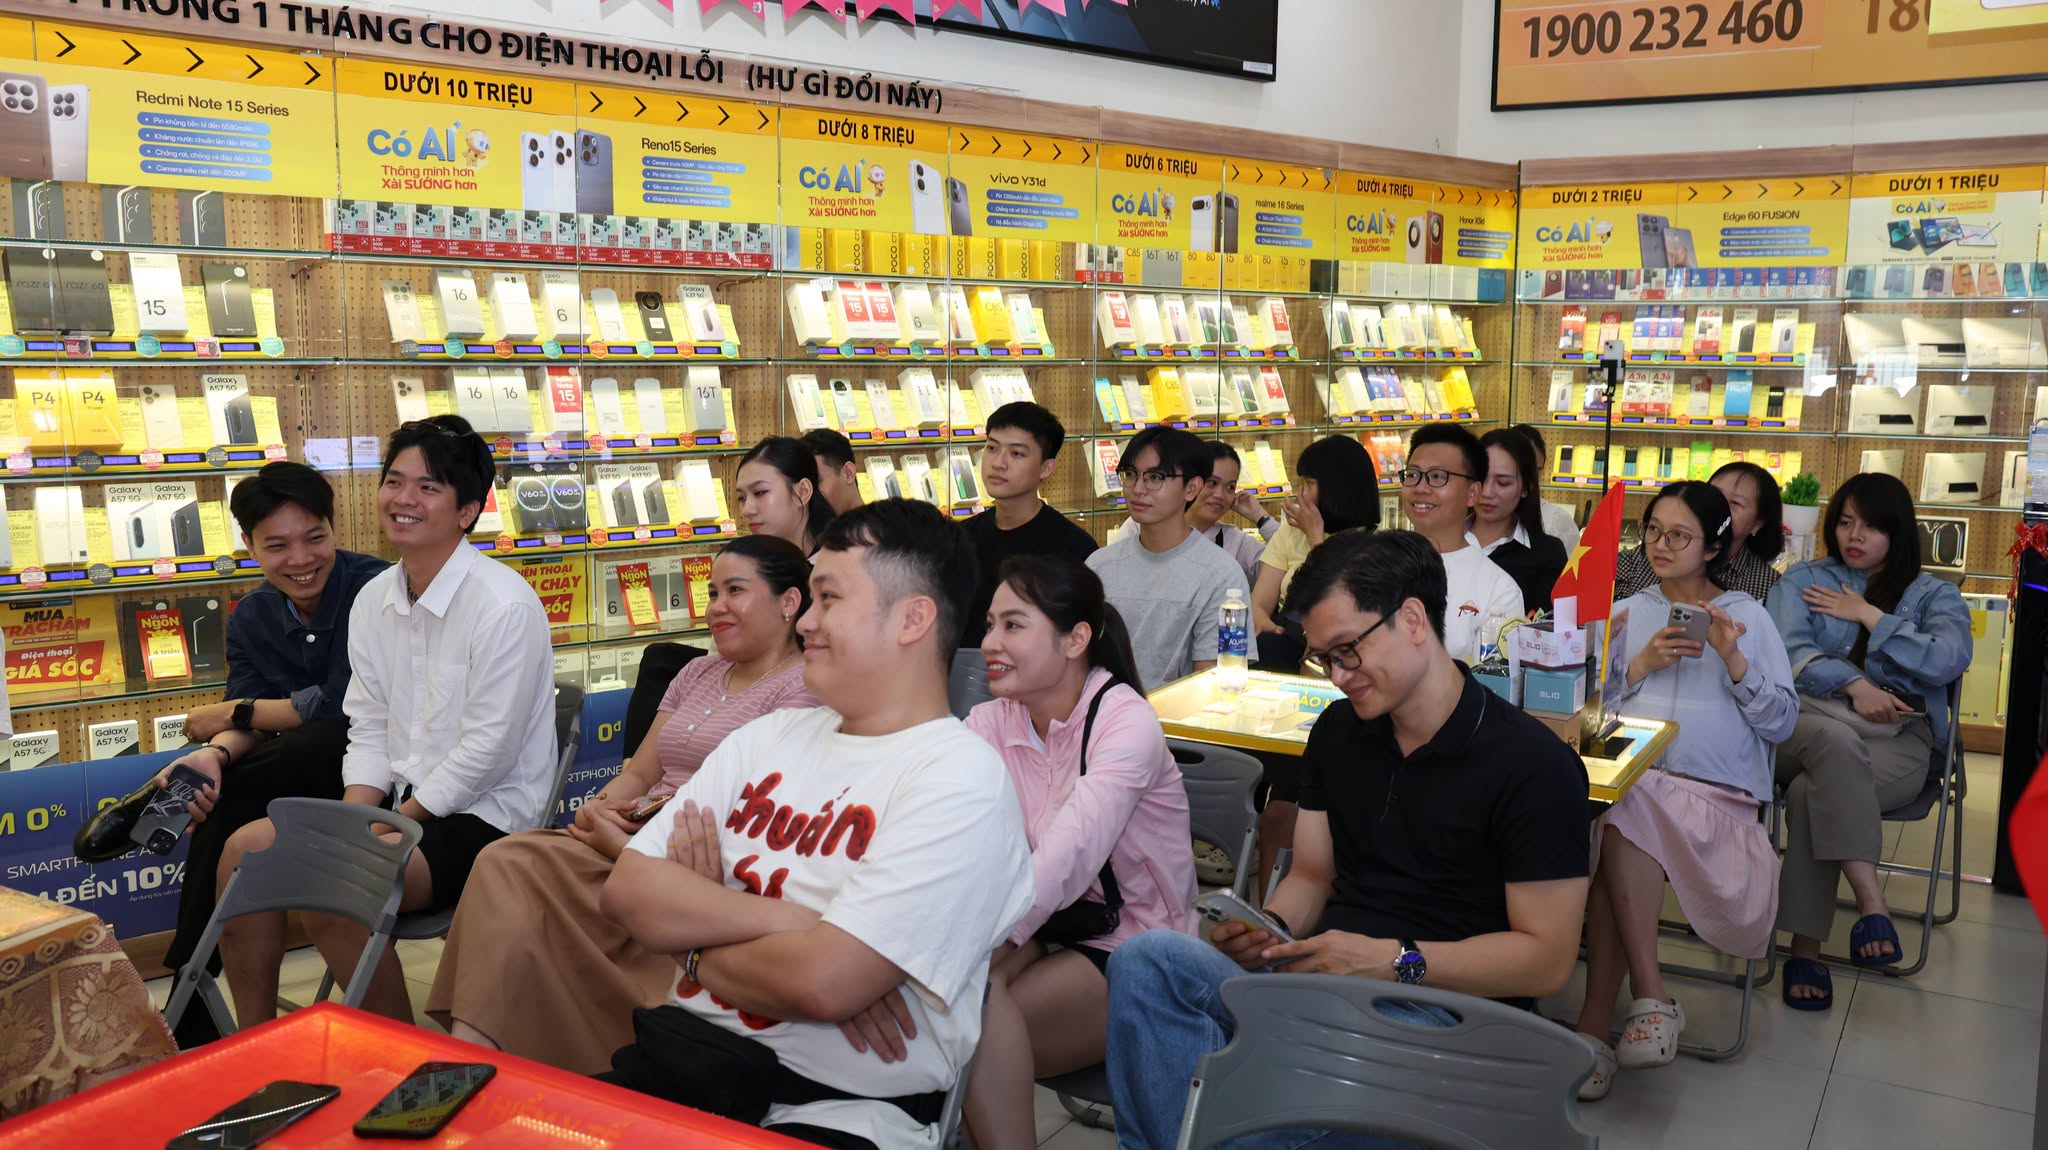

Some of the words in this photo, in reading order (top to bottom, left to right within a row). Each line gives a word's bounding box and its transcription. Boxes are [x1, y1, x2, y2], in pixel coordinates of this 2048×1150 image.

[1863, 0, 1930, 34] 18
[1523, 12, 1622, 58] 1900
[1629, 3, 1708, 51] 232
[1717, 0, 1803, 44] 460
[253, 1, 268, 28] 1
[280, 3, 412, 44] THÁNG
[420, 22, 492, 54] CHO
[500, 32, 574, 67] ĐIỆN
[581, 42, 672, 81] THOẠI
[681, 48, 723, 83] LỖI
[384, 71, 440, 95] DƯỚI
[447, 78, 468, 98] 10
[474, 81, 533, 108] TRIỆU
[747, 54, 798, 92] (HƯ
[803, 70, 829, 97] GÌ
[835, 72, 880, 103] ĐỔI
[888, 81, 942, 114] NẤY)
[136, 90, 184, 107] Redmi
[188, 95, 222, 110] Note
[226, 100, 243, 112] 15
[247, 101, 289, 117] Series
[818, 118, 856, 138] DƯỚI
[861, 124, 869, 140] 8
[873, 125, 915, 147] TRIỆU
[367, 128, 412, 158] Có
[418, 126, 455, 162] AI
[641, 137, 681, 152] Reno15
[684, 141, 717, 156] Series
[381, 164, 420, 178] Thông
[423, 166, 450, 177] minh
[453, 166, 474, 177] hơn
[1126, 152, 1155, 171] DƯỚI
[1157, 157, 1163, 171] 6
[1166, 158, 1198, 177] TRIỆU
[382, 178, 402, 190] Xài
[405, 176, 452, 190] SƯỚNG
[455, 179, 477, 190] hơn
[799, 166, 831, 190] Có
[835, 163, 862, 193] AI
[990, 172, 1019, 185] vivo
[1021, 176, 1046, 187] Y31d
[1889, 176, 1931, 192] DƯỚI
[1936, 177, 1943, 189] 1
[1950, 174, 1999, 191] TRIỆU
[1357, 179, 1380, 193] DƯỚI
[1382, 183, 1387, 194] 4
[1389, 183, 1413, 199] TRIỆU
[808, 196, 836, 207] Thông
[838, 197, 857, 207] minh
[859, 197, 874, 206] hơn
[1552, 188, 1587, 204] DƯỚI
[1591, 191, 1598, 202] 2
[1602, 189, 1642, 204] TRIỆU
[1112, 194, 1135, 214] Có
[1138, 191, 1158, 217] AI
[1277, 200, 1285, 209] 16
[1896, 203, 1914, 214] Có
[1916, 201, 1931, 213] AI
[808, 207, 823, 216] Xài
[825, 206, 858, 217] SƯỚNG
[860, 208, 876, 216] hơn
[1723, 212, 1746, 222] Edge
[1748, 210, 1760, 220] 60
[1762, 210, 1800, 220] FUSION
[1118, 220, 1139, 229] Thông
[1347, 214, 1365, 233] Có
[1367, 212, 1383, 234] AI
[1536, 225, 1563, 243] Có
[1566, 222, 1590, 242] AI
[1126, 247, 1141, 258] C85
[1146, 250, 1160, 260] 16T
[1166, 251, 1179, 261] 16T
[1187, 251, 1197, 261] 80
[1206, 252, 1215, 262] 80
[1244, 253, 1253, 264] 80
[1262, 254, 1271, 265] 80
[16, 281, 41, 289] razr
[65, 282, 89, 290] razr
[91, 282, 105, 290] 60
[683, 285, 705, 293] Galaxy
[452, 288, 467, 300] 16
[143, 299, 167, 316] 15
[556, 308, 568, 322] 6
[913, 316, 922, 328] 6
[207, 376, 237, 386] Galaxy
[32, 391, 56, 405] P4
[82, 391, 105, 404] P4
[468, 387, 482, 399] 16
[503, 387, 518, 399] 16
[559, 390, 575, 402] 15
[697, 386, 716, 399] 16T
[109, 486, 142, 495] Galaxy
[155, 484, 186, 493] Galaxy
[521, 490, 538, 498] V60
[555, 488, 573, 496] V60
[111, 494, 127, 503] A57
[129, 493, 141, 502] 5G
[157, 493, 172, 501] A57
[174, 493, 186, 501] 5G
[518, 566, 537, 580] IỆN
[540, 564, 572, 576] THOẠI
[541, 576, 582, 593] CHẠY
[608, 600, 617, 614] 6
[671, 594, 680, 607] 6
[24, 608, 65, 623] MUA
[21, 650, 44, 661] Điện
[47, 646, 72, 658] thoại
[5, 660, 42, 680] GIÁ
[48, 654, 94, 678] SỐC
[1299, 690, 1322, 708] ẢO
[95, 726, 129, 738] Galaxy
[161, 731, 177, 739] A57
[12, 738, 49, 748] Galaxy
[96, 738, 112, 747] A57
[114, 736, 127, 744] 5G
[13, 748, 31, 758] A57
[55, 873, 118, 905] ĐẾN
[123, 861, 186, 893] 10%
